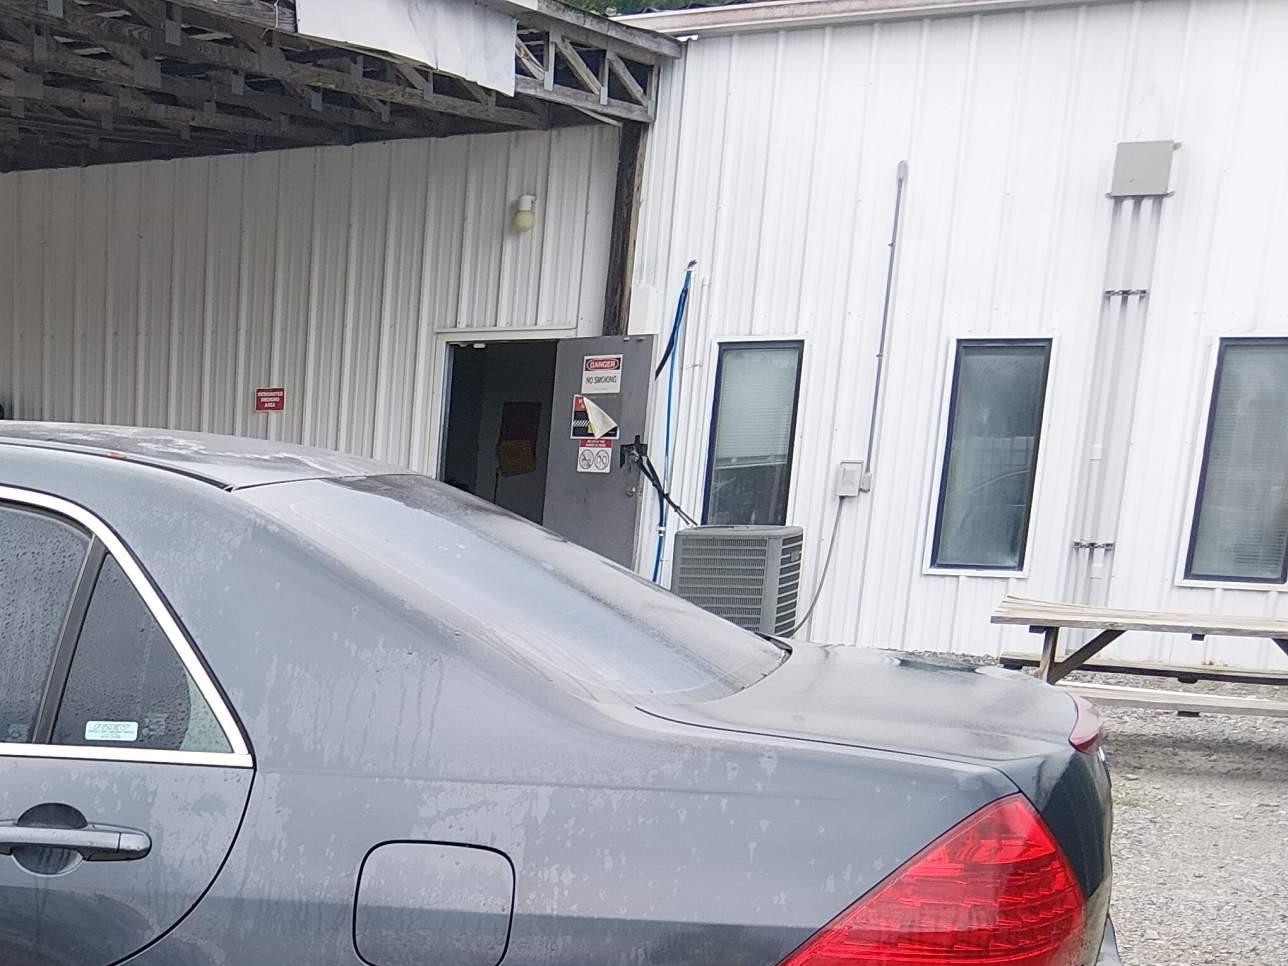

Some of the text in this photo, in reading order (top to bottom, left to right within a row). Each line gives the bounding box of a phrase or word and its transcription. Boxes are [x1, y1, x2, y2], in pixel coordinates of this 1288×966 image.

[589, 360, 616, 369] DANGER
[585, 375, 617, 384] NO SMOKING
